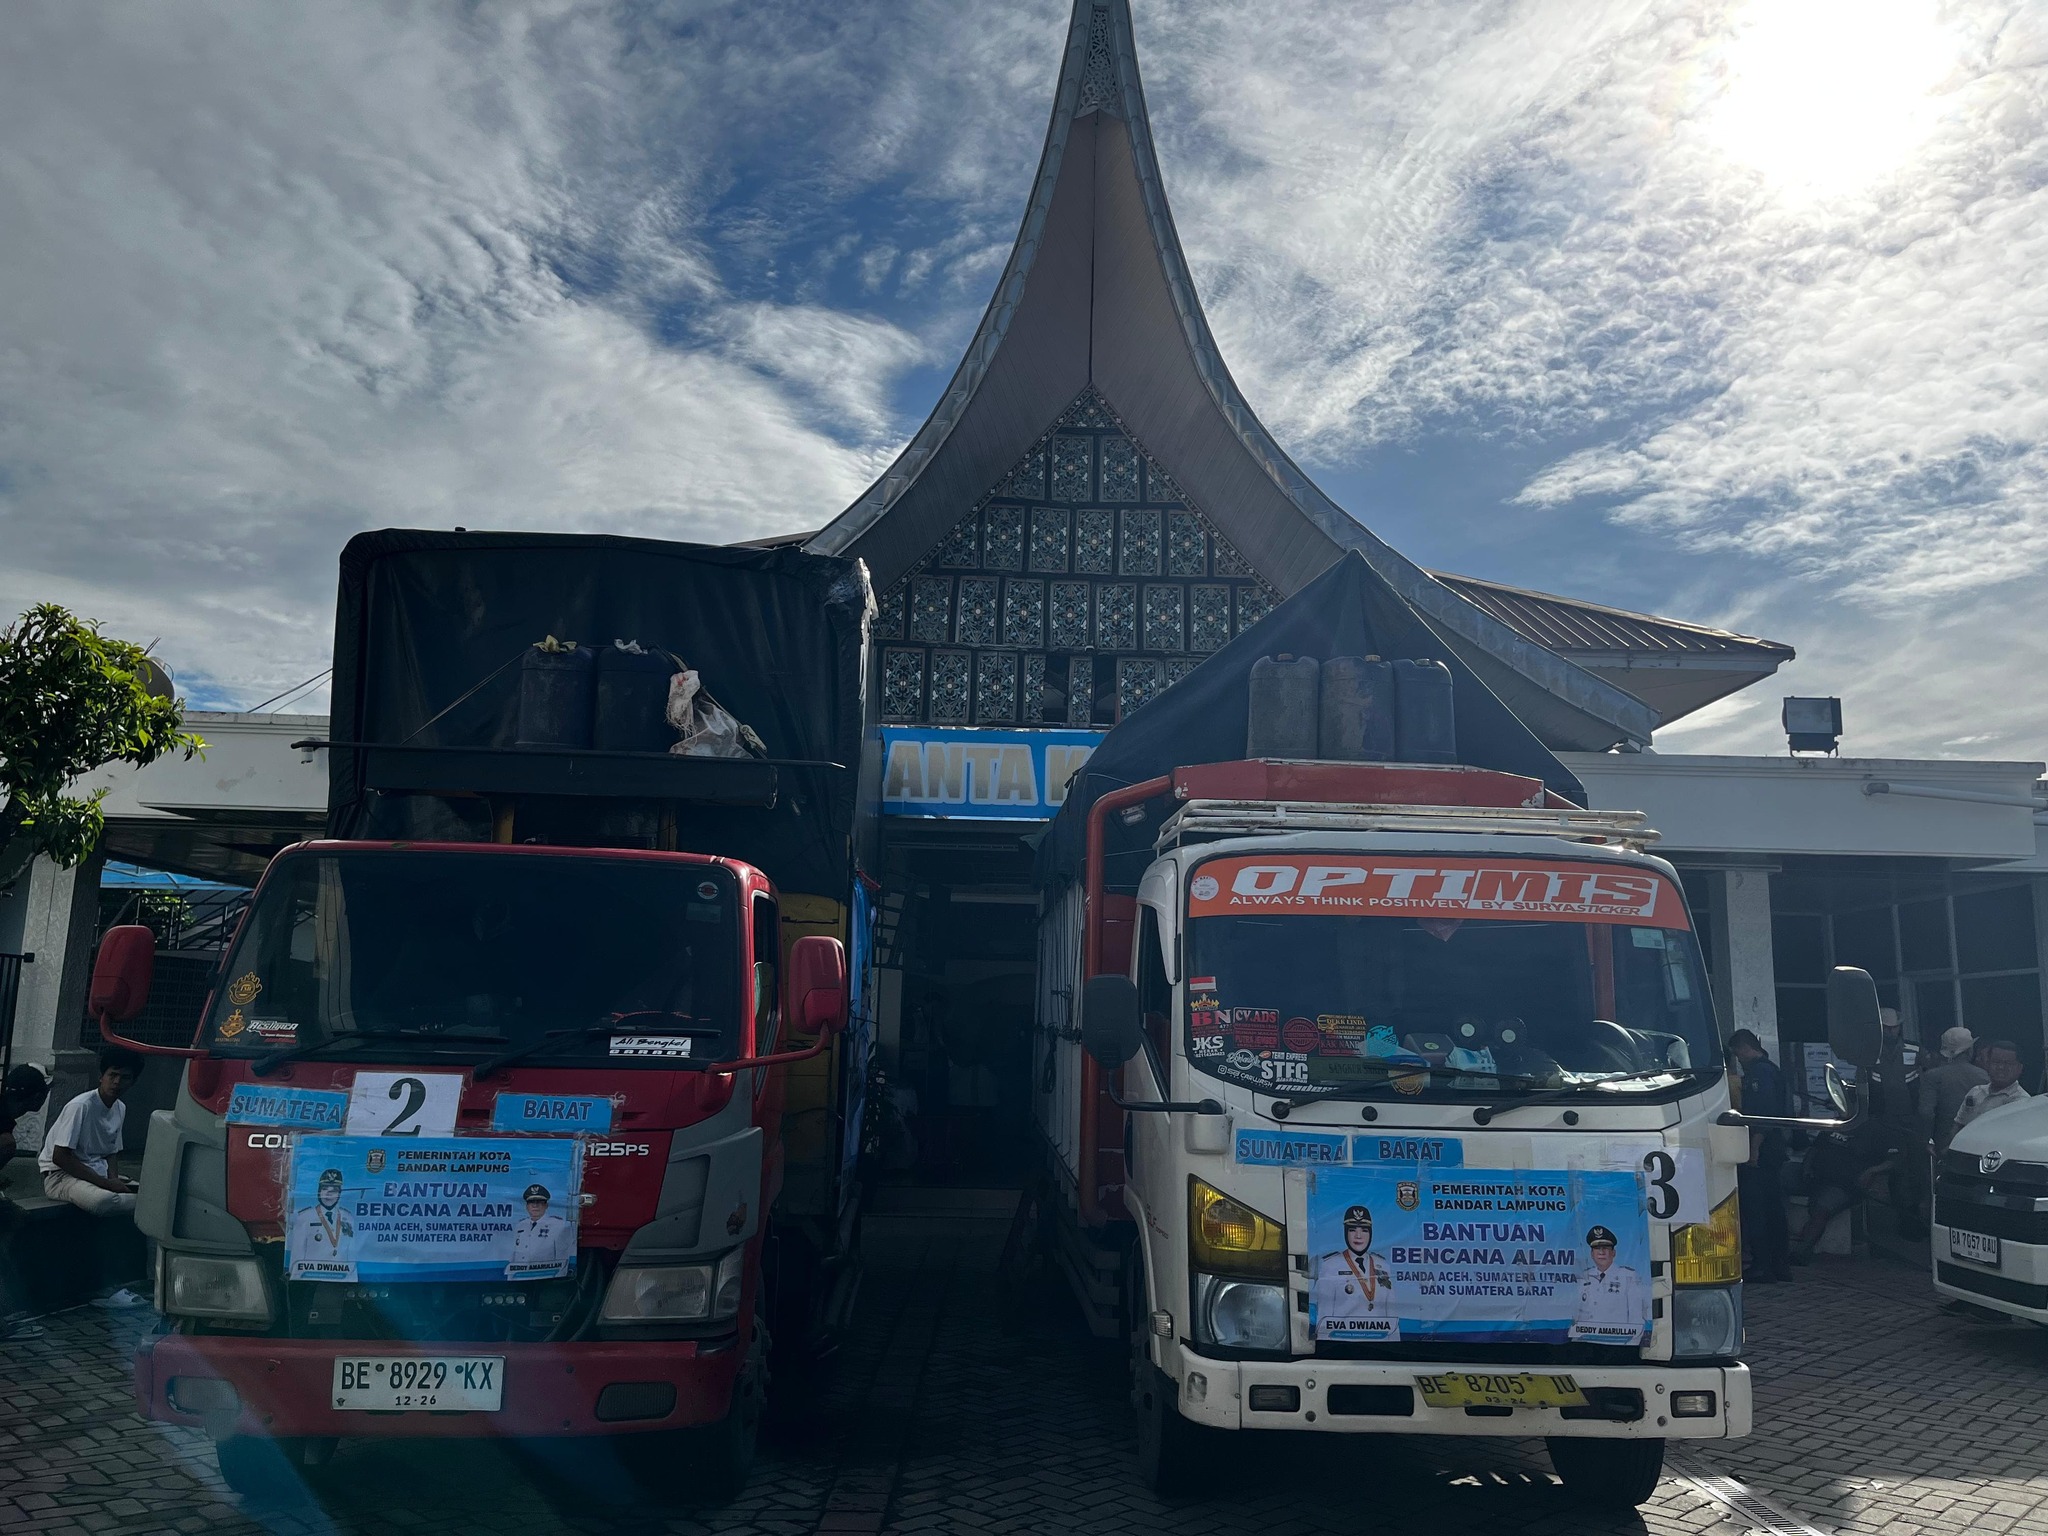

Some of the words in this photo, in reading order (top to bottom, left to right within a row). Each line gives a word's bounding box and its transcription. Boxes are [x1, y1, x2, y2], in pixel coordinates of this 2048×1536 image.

[1231, 865, 1653, 906] OPTIMIS
[1229, 896, 1306, 905] ALWAYS
[1310, 896, 1364, 906] THINK
[1369, 898, 1469, 909] POSITIVELY
[1481, 901, 1505, 909] BY
[1192, 1036, 1224, 1051] JKS
[231, 1095, 341, 1124] SUMATERA
[523, 1099, 592, 1121] BARAT
[381, 1077, 426, 1136] 2
[397, 1150, 476, 1161] PEMERINTAH
[479, 1151, 512, 1162] KOTA
[587, 1142, 650, 1157] 125PS
[1238, 1138, 1345, 1162] SUMATERA
[1378, 1140, 1444, 1161] BARAT
[397, 1163, 447, 1173] BANDAR
[449, 1164, 510, 1174] LAMPUNG
[383, 1182, 488, 1198] BANTUAN
[1432, 1184, 1524, 1196] PEMERINTAH
[1528, 1185, 1566, 1197] KOTA
[1643, 1151, 1680, 1219] 3
[356, 1202, 451, 1217] BENCANA
[456, 1203, 513, 1218] ALAM
[1434, 1199, 1493, 1211] BANDAR
[1497, 1200, 1566, 1212] LAMPUNG
[358, 1222, 391, 1231] BANDA
[393, 1222, 423, 1233] ACEH,
[425, 1223, 478, 1232] SUMATERA
[481, 1223, 513, 1232] UTARA
[1423, 1222, 1546, 1242] BANTUAN
[377, 1233, 399, 1242] DAN
[401, 1233, 457, 1242] SUMATERA
[459, 1233, 493, 1243] BARAT
[1391, 1247, 1505, 1265] BENCANA
[1511, 1248, 1575, 1266] ALAM
[297, 1262, 315, 1271] EVA
[317, 1263, 350, 1272] DWIANA
[1396, 1271, 1435, 1282] BANDA
[1475, 1272, 1536, 1283] SUMATERA
[1539, 1272, 1578, 1284] UTARA
[1420, 1285, 1445, 1296] DAN
[1448, 1285, 1514, 1296] SUMATERA
[1517, 1286, 1554, 1297] BARAT
[1326, 1320, 1347, 1330] EVA
[1349, 1321, 1391, 1331] DWIANA
[1575, 1325, 1597, 1334] DEDDY
[1598, 1326, 1637, 1335] AMARULLAH
[341, 1361, 370, 1390] BE
[389, 1361, 447, 1390] 8929
[463, 1361, 494, 1390] KX
[1417, 1375, 1451, 1394] BE
[1465, 1375, 1525, 1395] 8205
